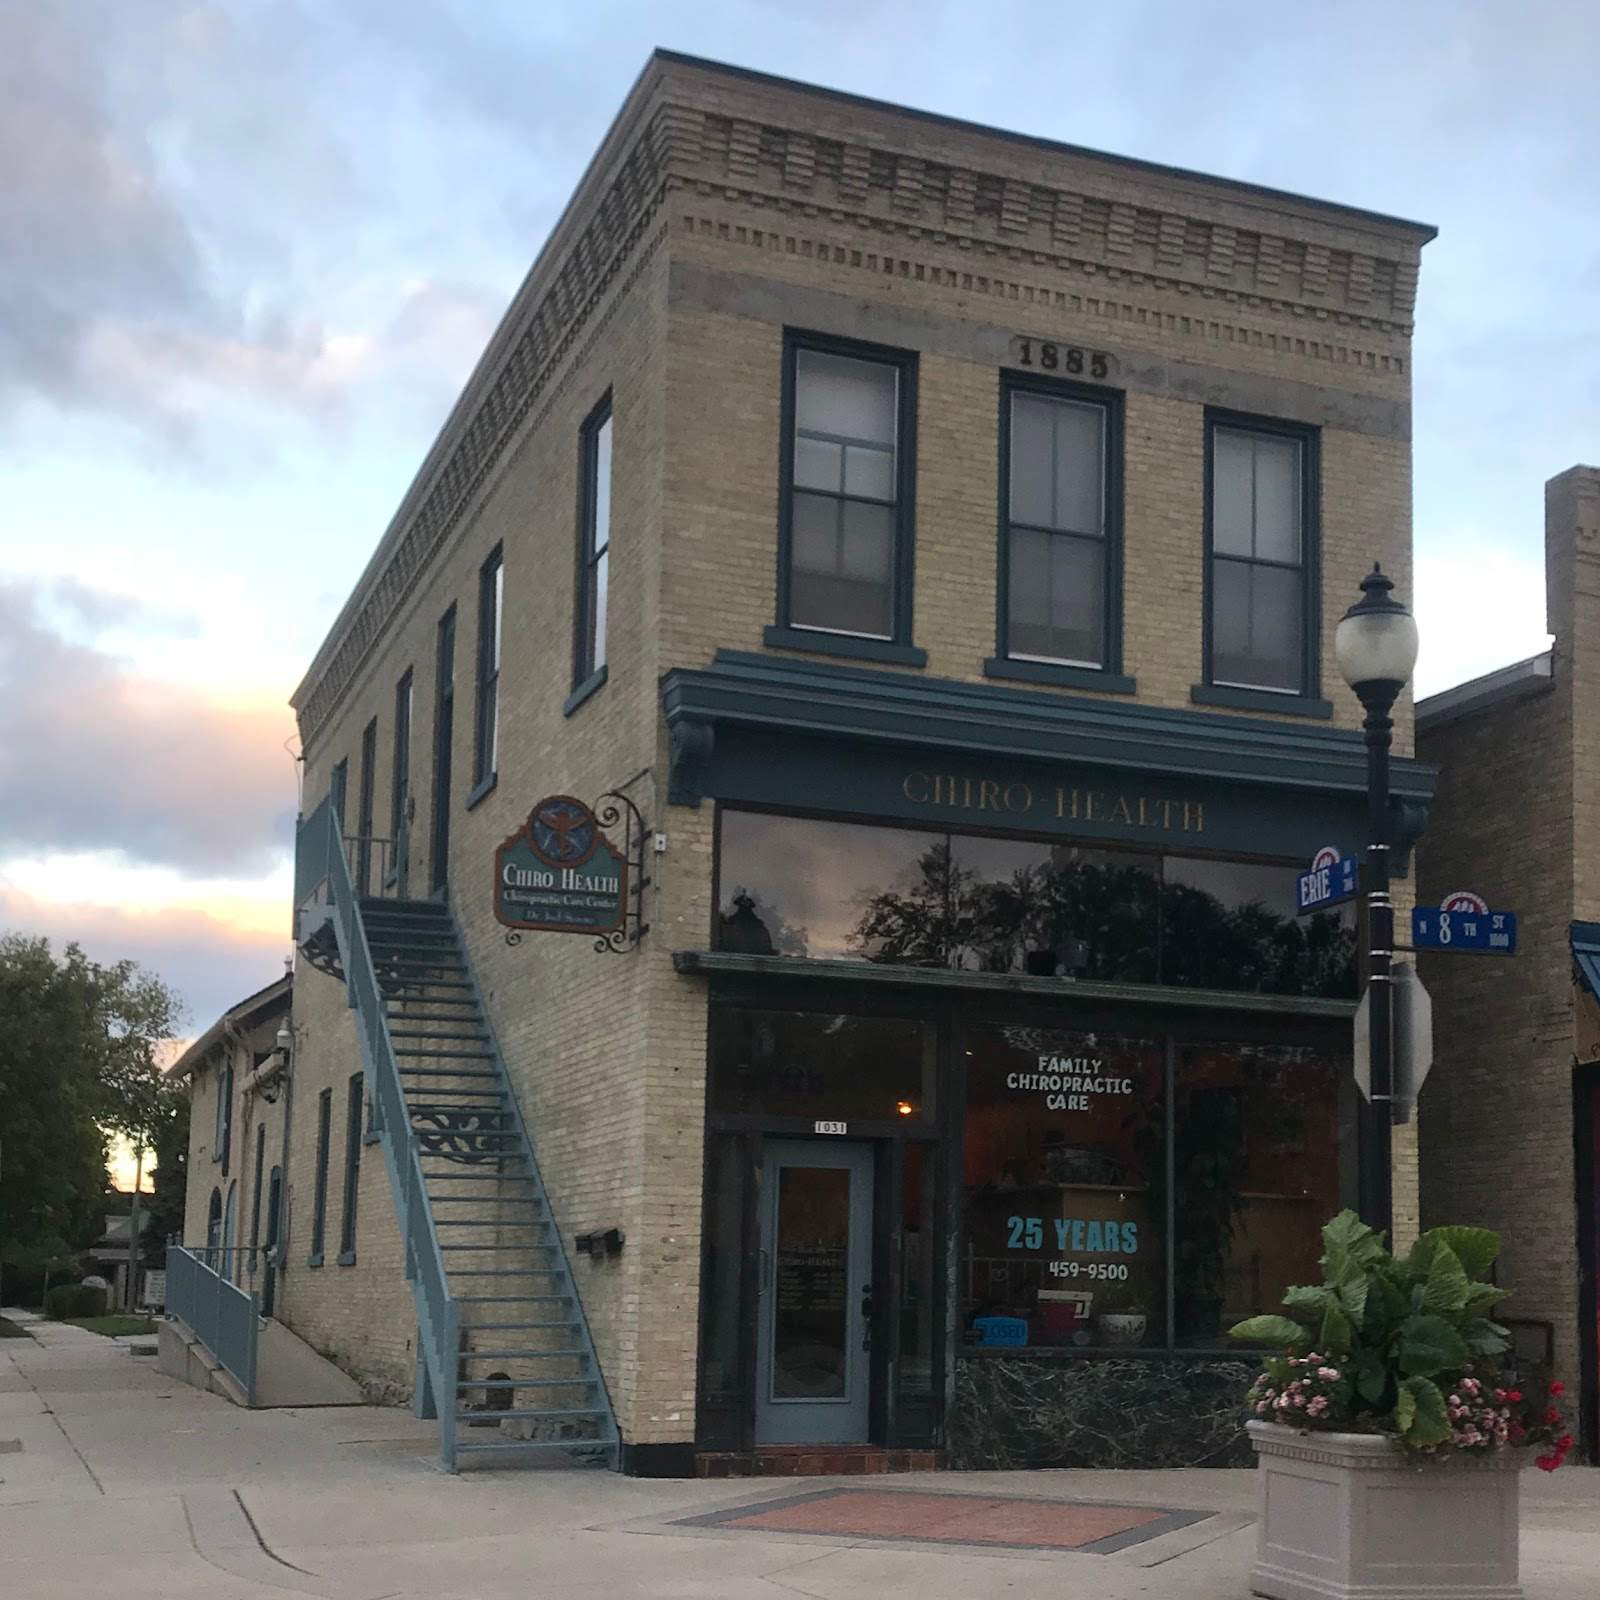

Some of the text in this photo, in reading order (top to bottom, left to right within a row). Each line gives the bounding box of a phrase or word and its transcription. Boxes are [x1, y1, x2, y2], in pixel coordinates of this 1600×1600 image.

[1020, 340, 1108, 379] 1885
[503, 863, 619, 893] CHIRO HEALTH
[1300, 868, 1331, 906] ERIE
[1439, 913, 1452, 944] 8
[1464, 922, 1477, 937] TH
[1492, 914, 1505, 929] ST
[1038, 1056, 1102, 1074] FAMILY
[1007, 1073, 1132, 1094] CHIROPRACTIC
[1046, 1094, 1089, 1111] CARE
[816, 1122, 845, 1133] 1031
[1007, 1216, 1138, 1254] 25 YEARS
[1049, 1260, 1129, 1281] 459-9500
